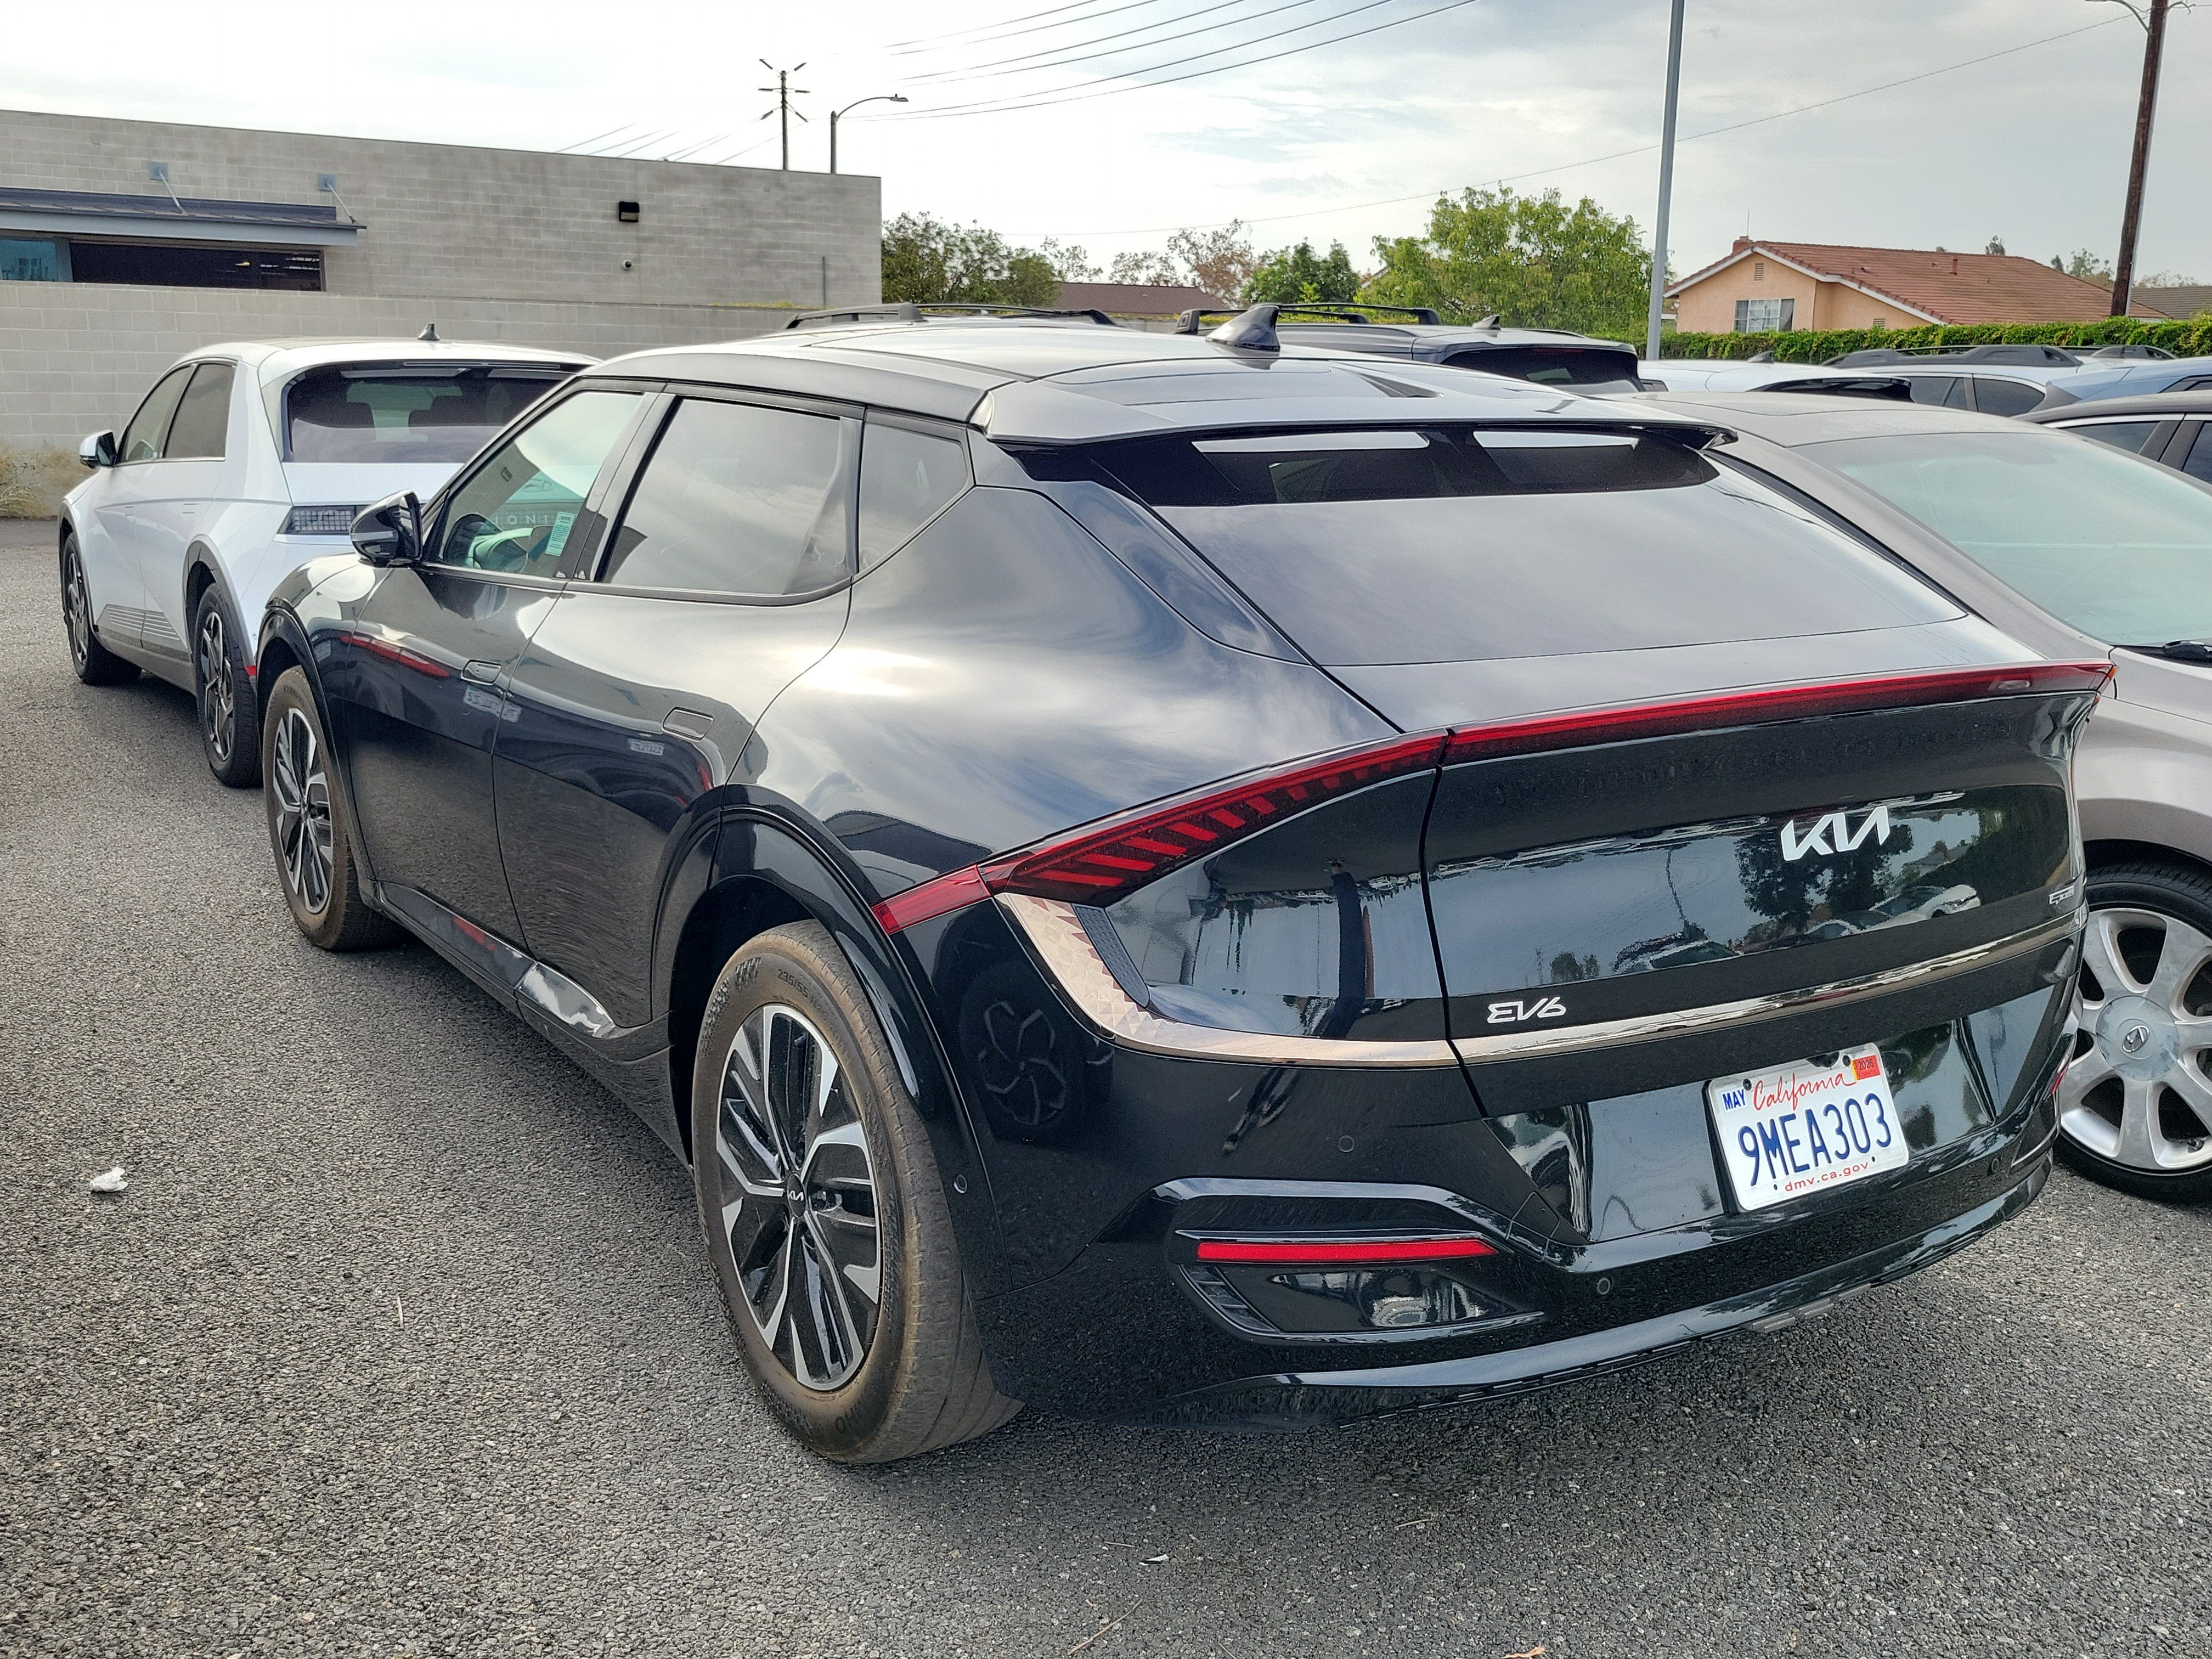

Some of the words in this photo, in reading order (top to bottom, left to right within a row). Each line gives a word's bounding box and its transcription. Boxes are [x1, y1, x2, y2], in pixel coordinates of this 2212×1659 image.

[495, 515, 548, 526] IONI
[1781, 806, 1891, 861] KIA
[778, 969, 809, 998] 235/55
[1487, 996, 1566, 1024] EV6
[1722, 1089, 1746, 1110] MAY
[1753, 1073, 1858, 1111] California
[1737, 1092, 1892, 1187] 9MEA303
[1785, 1162, 1869, 1192] dmv.ca.gov
